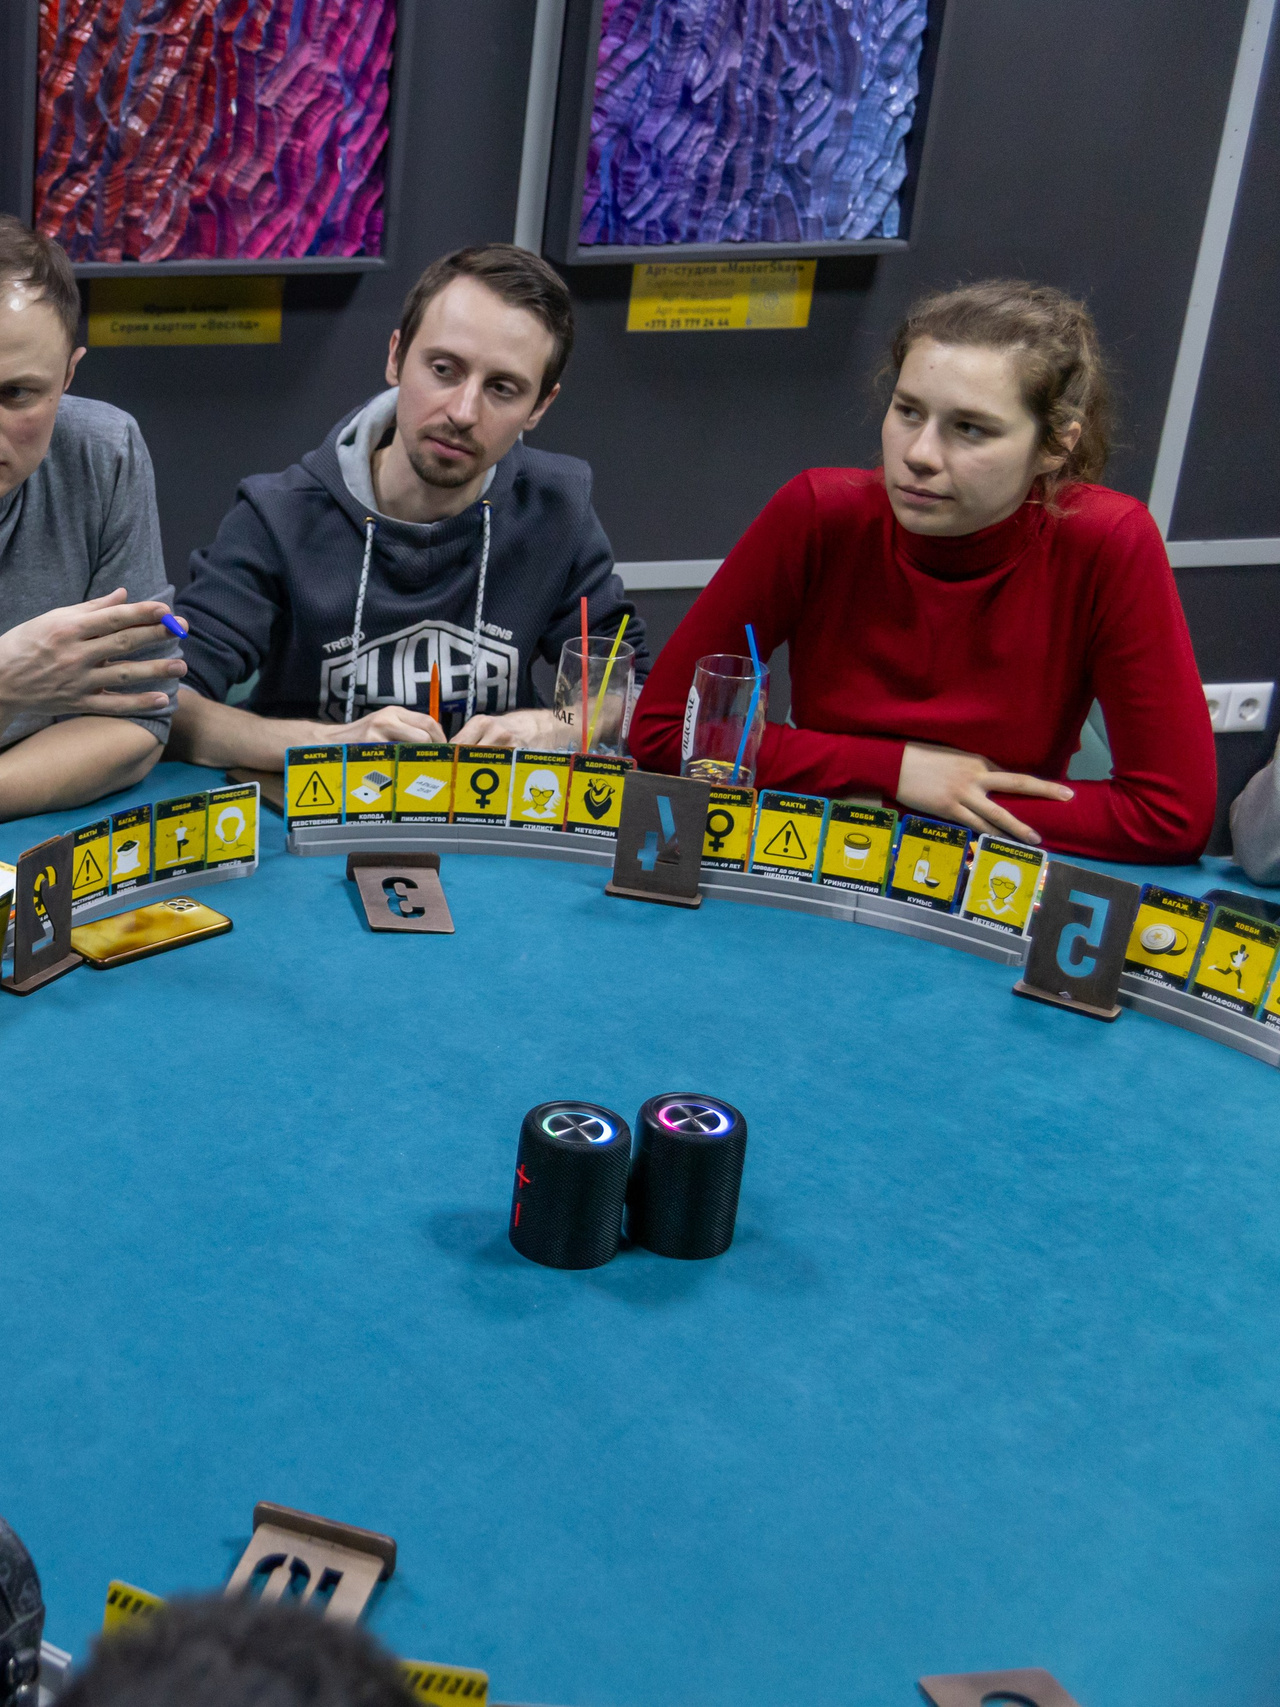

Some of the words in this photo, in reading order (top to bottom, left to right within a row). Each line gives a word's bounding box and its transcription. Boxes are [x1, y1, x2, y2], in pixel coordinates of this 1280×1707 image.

[322, 630, 366, 653] TREND
[303, 752, 327, 760] ФАКТЫ
[469, 752, 505, 760] БИОЛОГИЯ
[524, 754, 566, 763] ПРОФЕССИЯ
[585, 761, 621, 771] ЗДОРОВЬЕ
[213, 789, 250, 801] ПРОФЕССИЯ
[709, 792, 741, 801] ИОЛОГИЯ
[779, 800, 807, 810] ФАКТЫ
[456, 816, 486, 824] ЖЕНЩИНА
[850, 811, 875, 821] ХОББИ
[291, 818, 338, 827] ДЕВСТВЕННИК
[522, 823, 554, 831] СТИЛИСТ
[574, 826, 616, 837] МЕТЕОРИЗМ
[922, 827, 949, 838] БАГАЖ
[990, 842, 1034, 859] ПРОФЕССИЯ
[752, 864, 778, 873] ДОВОДИТ
[787, 869, 813, 878] ОРГАЗМА
[822, 877, 880, 894] УРИНОТЕРАПИЯ
[907, 895, 933, 908] КУМЫС
[1161, 897, 1188, 911] БАГАЖ
[1234, 921, 1260, 936] ХОББИ
[1143, 967, 1163, 979] МАЗЬ
[1201, 991, 1244, 1012] МАРАФОНЫ
